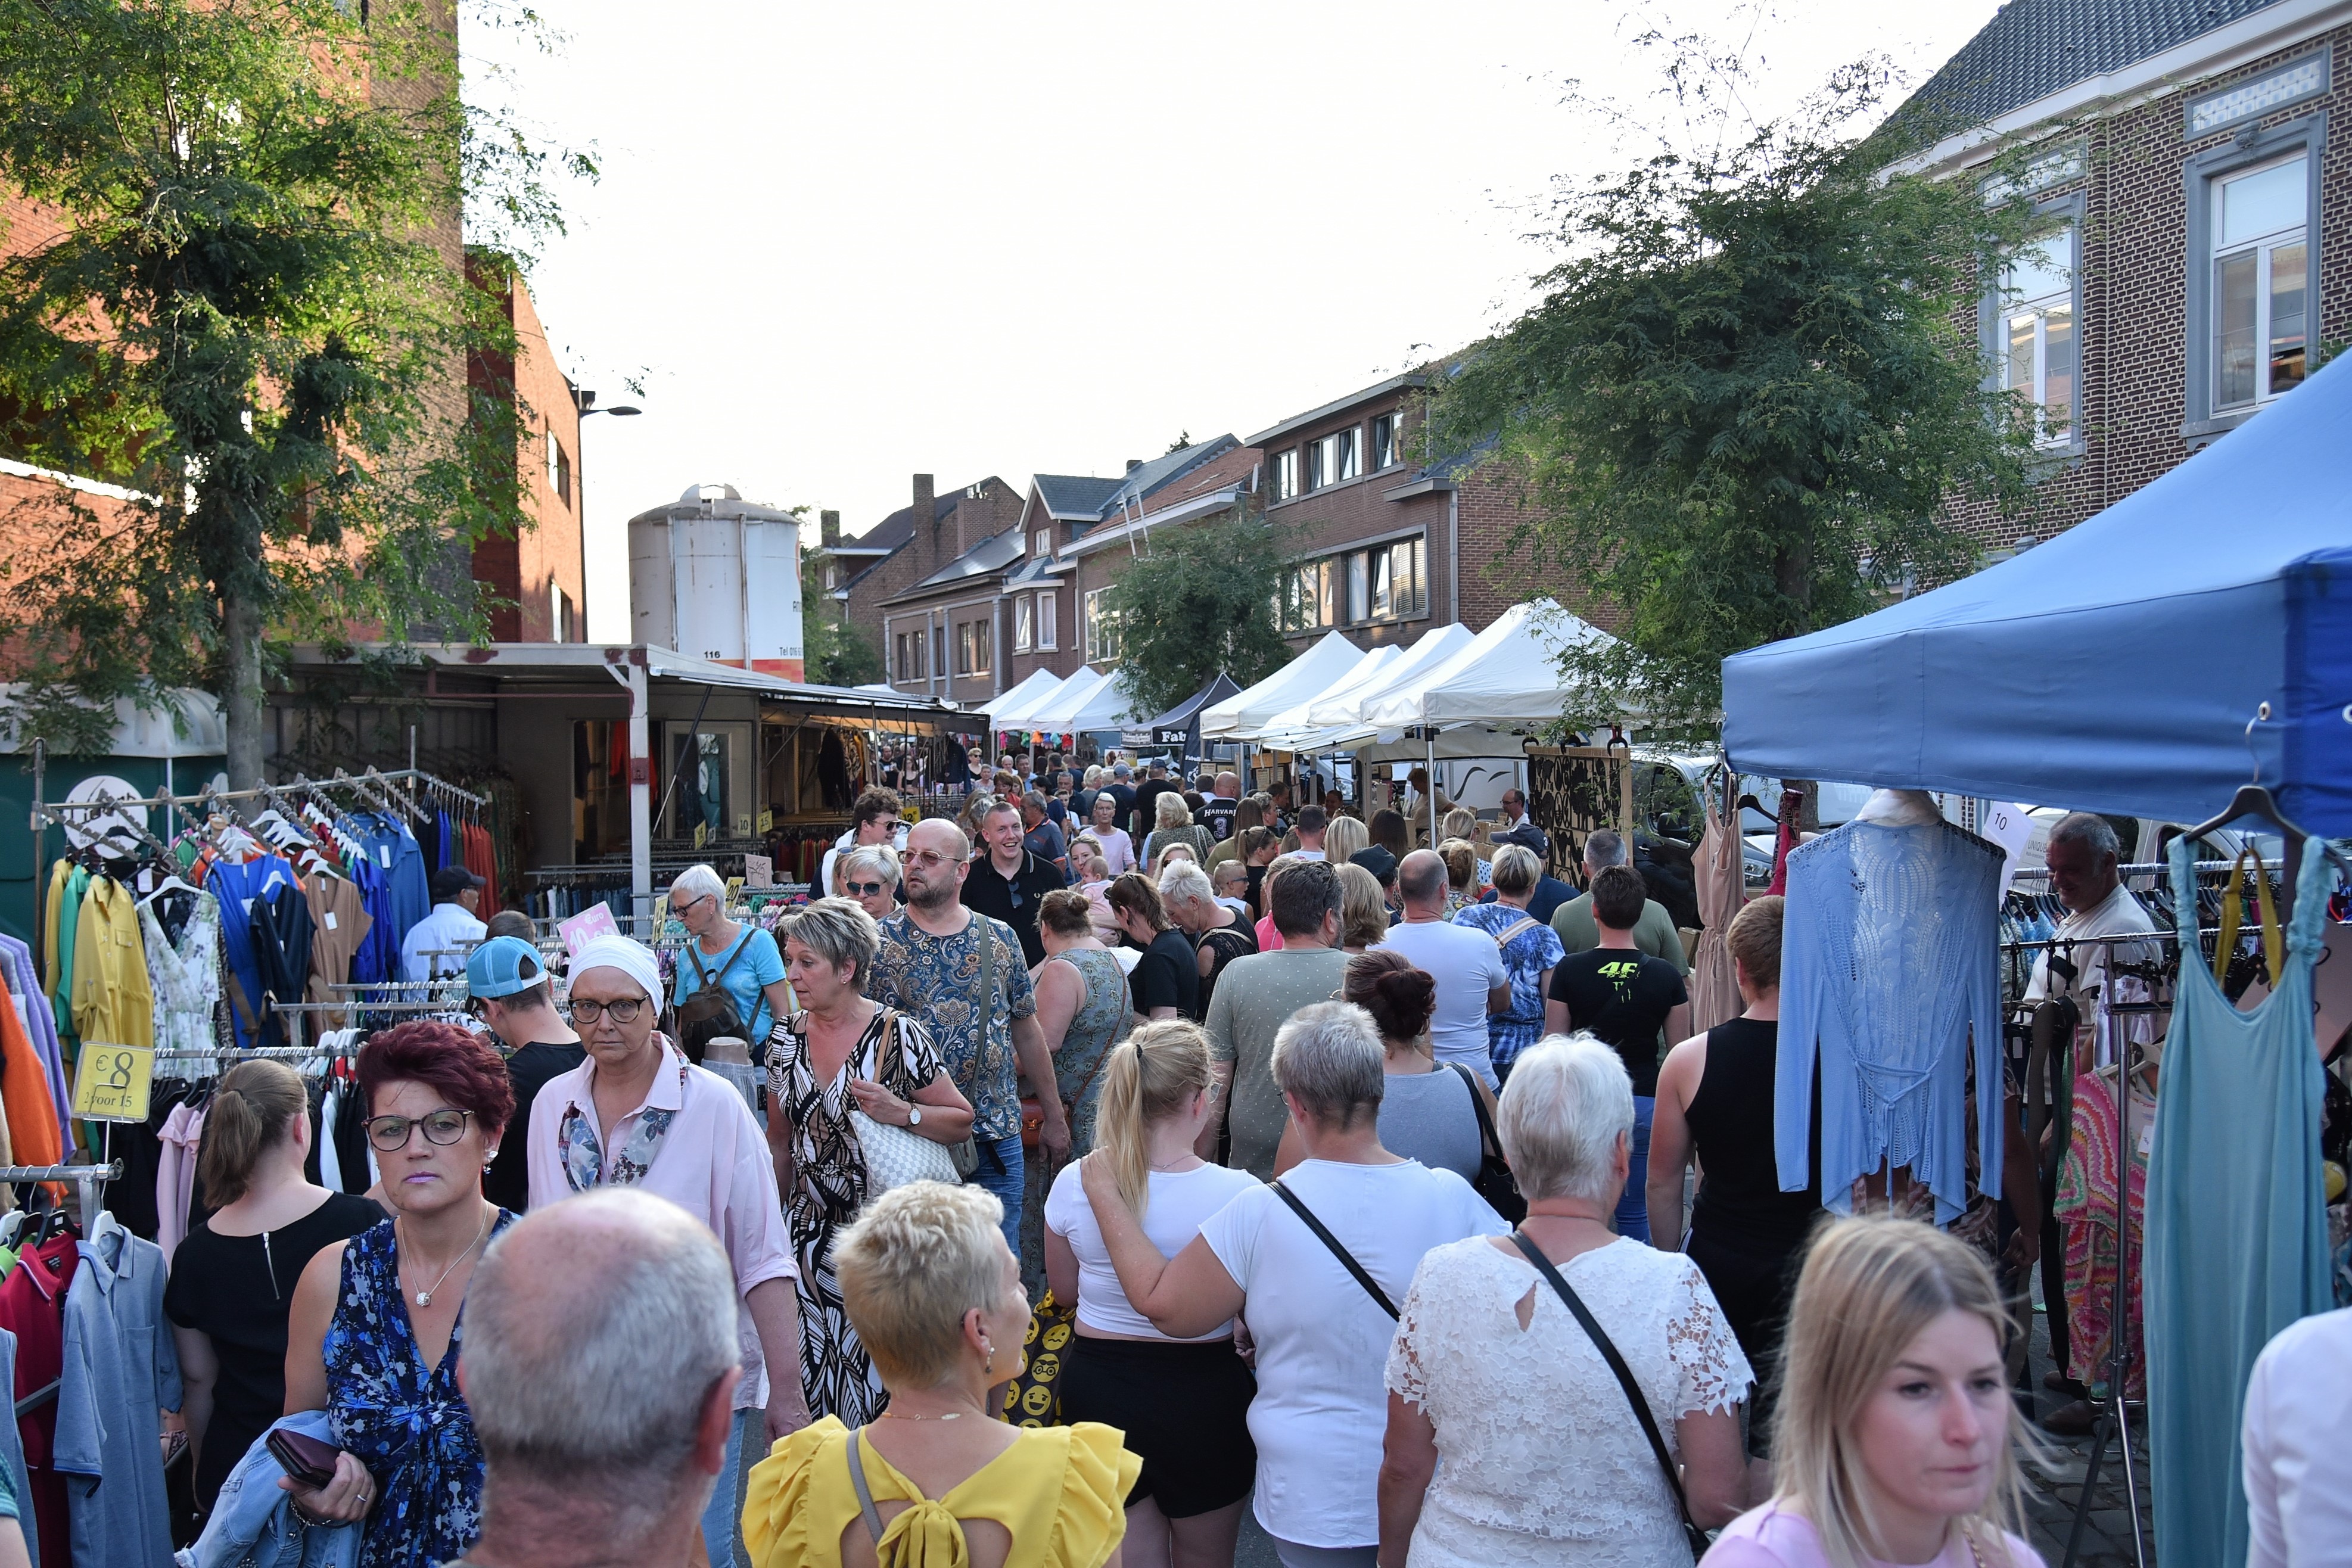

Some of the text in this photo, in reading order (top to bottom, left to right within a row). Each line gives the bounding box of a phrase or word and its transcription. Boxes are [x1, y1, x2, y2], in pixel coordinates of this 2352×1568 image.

[779, 646, 788, 656] Tel
[741, 819, 748, 830] 10
[1214, 817, 1227, 839] 3
[1995, 813, 2007, 830] 10
[726, 885, 739, 901] 20
[84, 1091, 132, 1107] 2 voor 15
